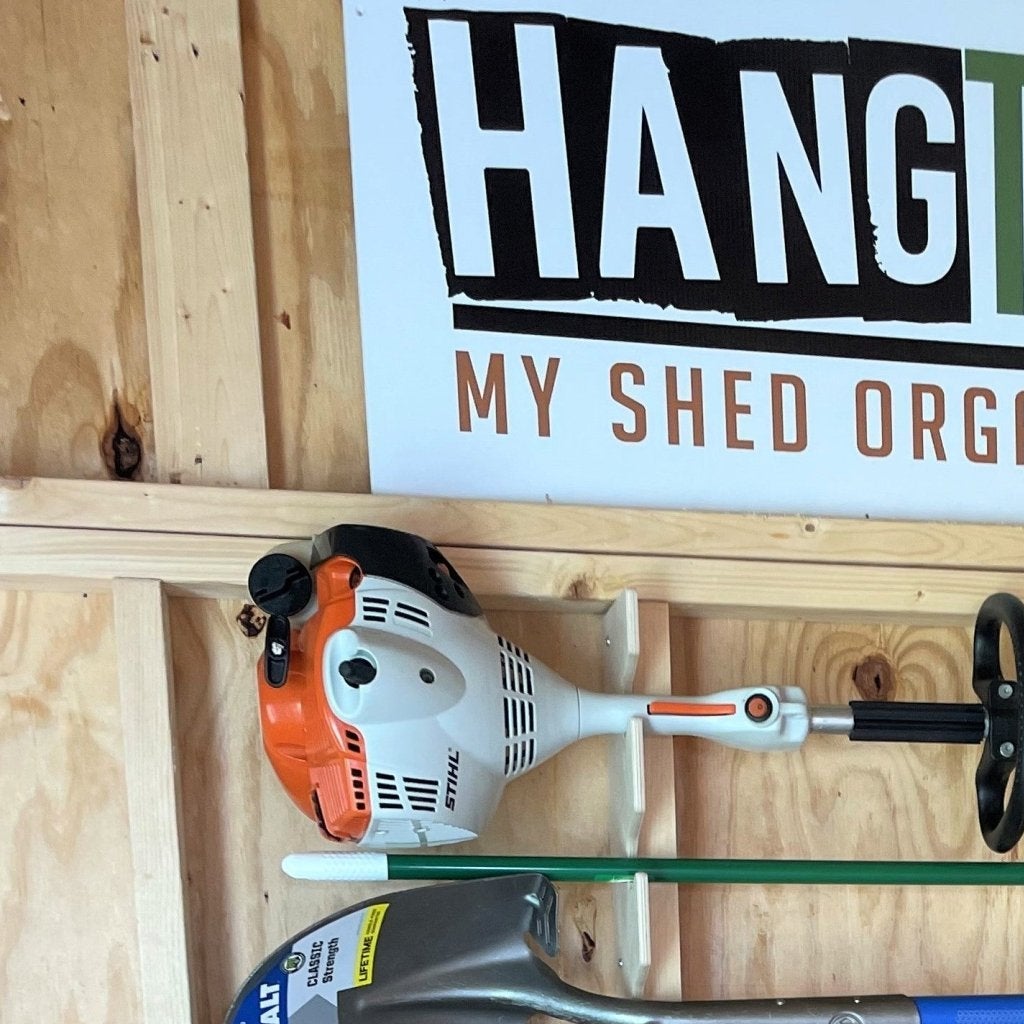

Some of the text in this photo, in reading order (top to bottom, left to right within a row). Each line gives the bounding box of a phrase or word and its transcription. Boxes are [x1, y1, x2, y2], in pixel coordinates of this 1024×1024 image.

[427, 19, 957, 286] HANG
[455, 350, 561, 437] MY
[609, 362, 809, 453] SHED
[445, 750, 460, 812] STIHL
[307, 940, 324, 988] CLASSIC
[322, 937, 339, 984] Strength
[358, 935, 374, 982] LIFETIME
